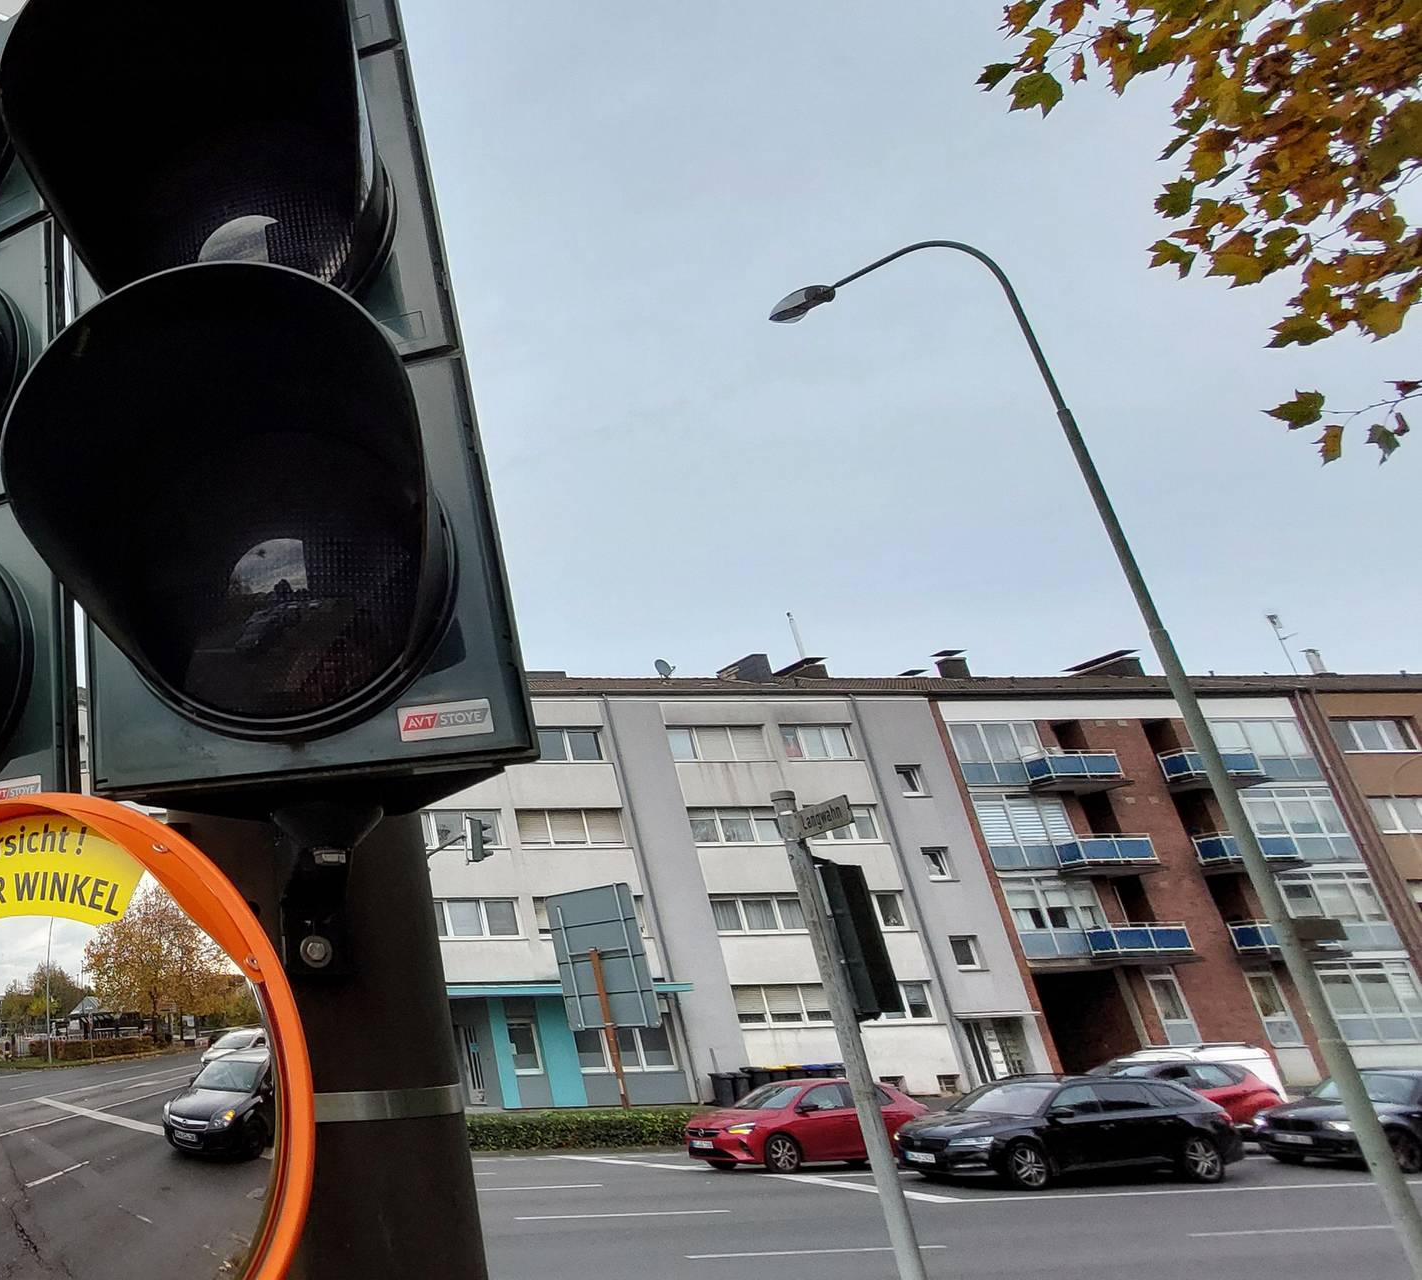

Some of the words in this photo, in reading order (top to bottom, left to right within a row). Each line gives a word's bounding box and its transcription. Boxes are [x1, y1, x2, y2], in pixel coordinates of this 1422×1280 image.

[407, 716, 435, 729] AVT
[440, 711, 483, 726] STOYE
[10, 785, 36, 797] STOYE
[801, 804, 843, 831] Langwahn
[75, 826, 88, 856] !
[14, 871, 119, 917] WINKEL
